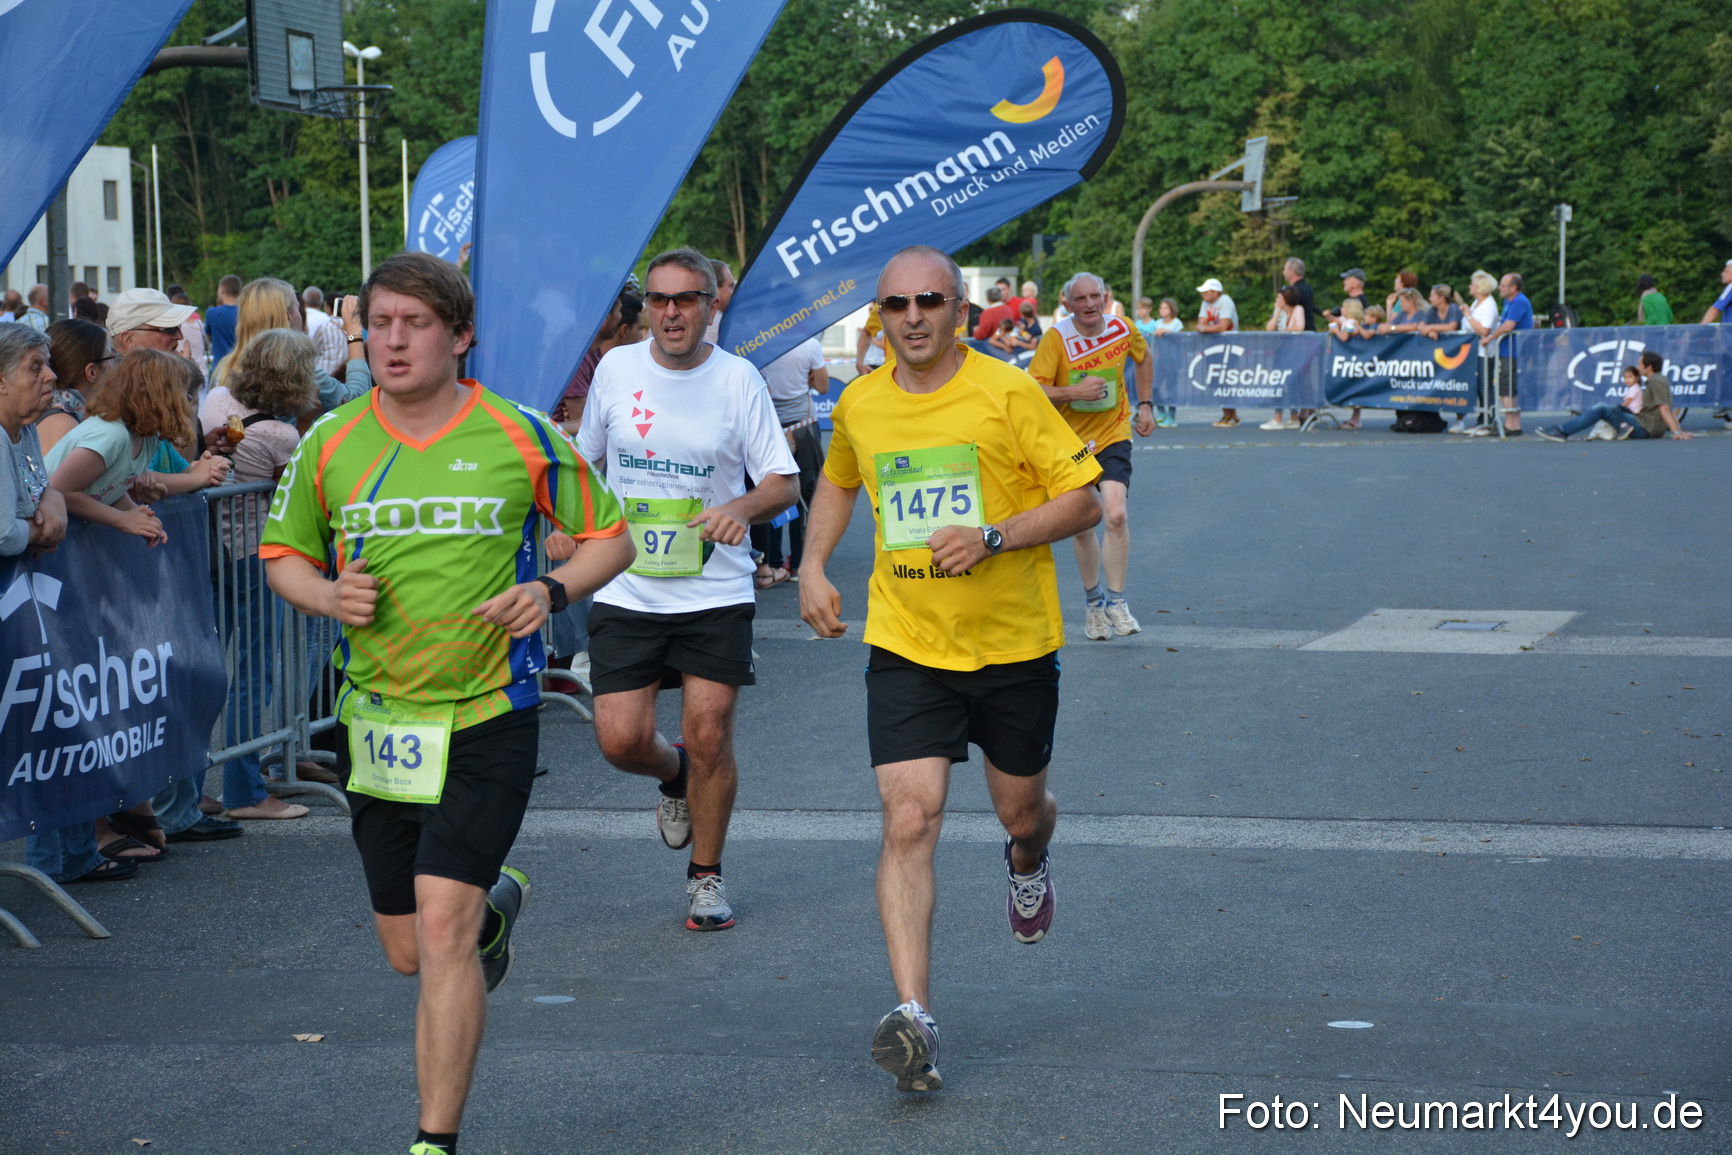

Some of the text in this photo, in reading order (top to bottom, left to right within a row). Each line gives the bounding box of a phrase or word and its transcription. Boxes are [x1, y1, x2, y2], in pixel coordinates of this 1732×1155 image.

[930, 113, 1101, 218] Druck und Medien
[775, 130, 1017, 280] Frischmann
[734, 276, 857, 360] frischmann-net.de
[1205, 363, 1292, 386] Fischer
[1331, 355, 1435, 378] Frischmann
[1594, 359, 1718, 385] Fiher
[1213, 388, 1284, 398] AUTOMOBILE
[618, 453, 715, 478] Gleichauf
[646, 470, 680, 480] Haustechnik
[340, 496, 506, 539] BOCK
[890, 484, 972, 522] 1475
[643, 529, 677, 555] 97
[0, 636, 174, 733] Fischer
[7, 716, 167, 787] AUTOMOBILE
[364, 729, 423, 770] 143
[393, 777, 412, 786] Bock
